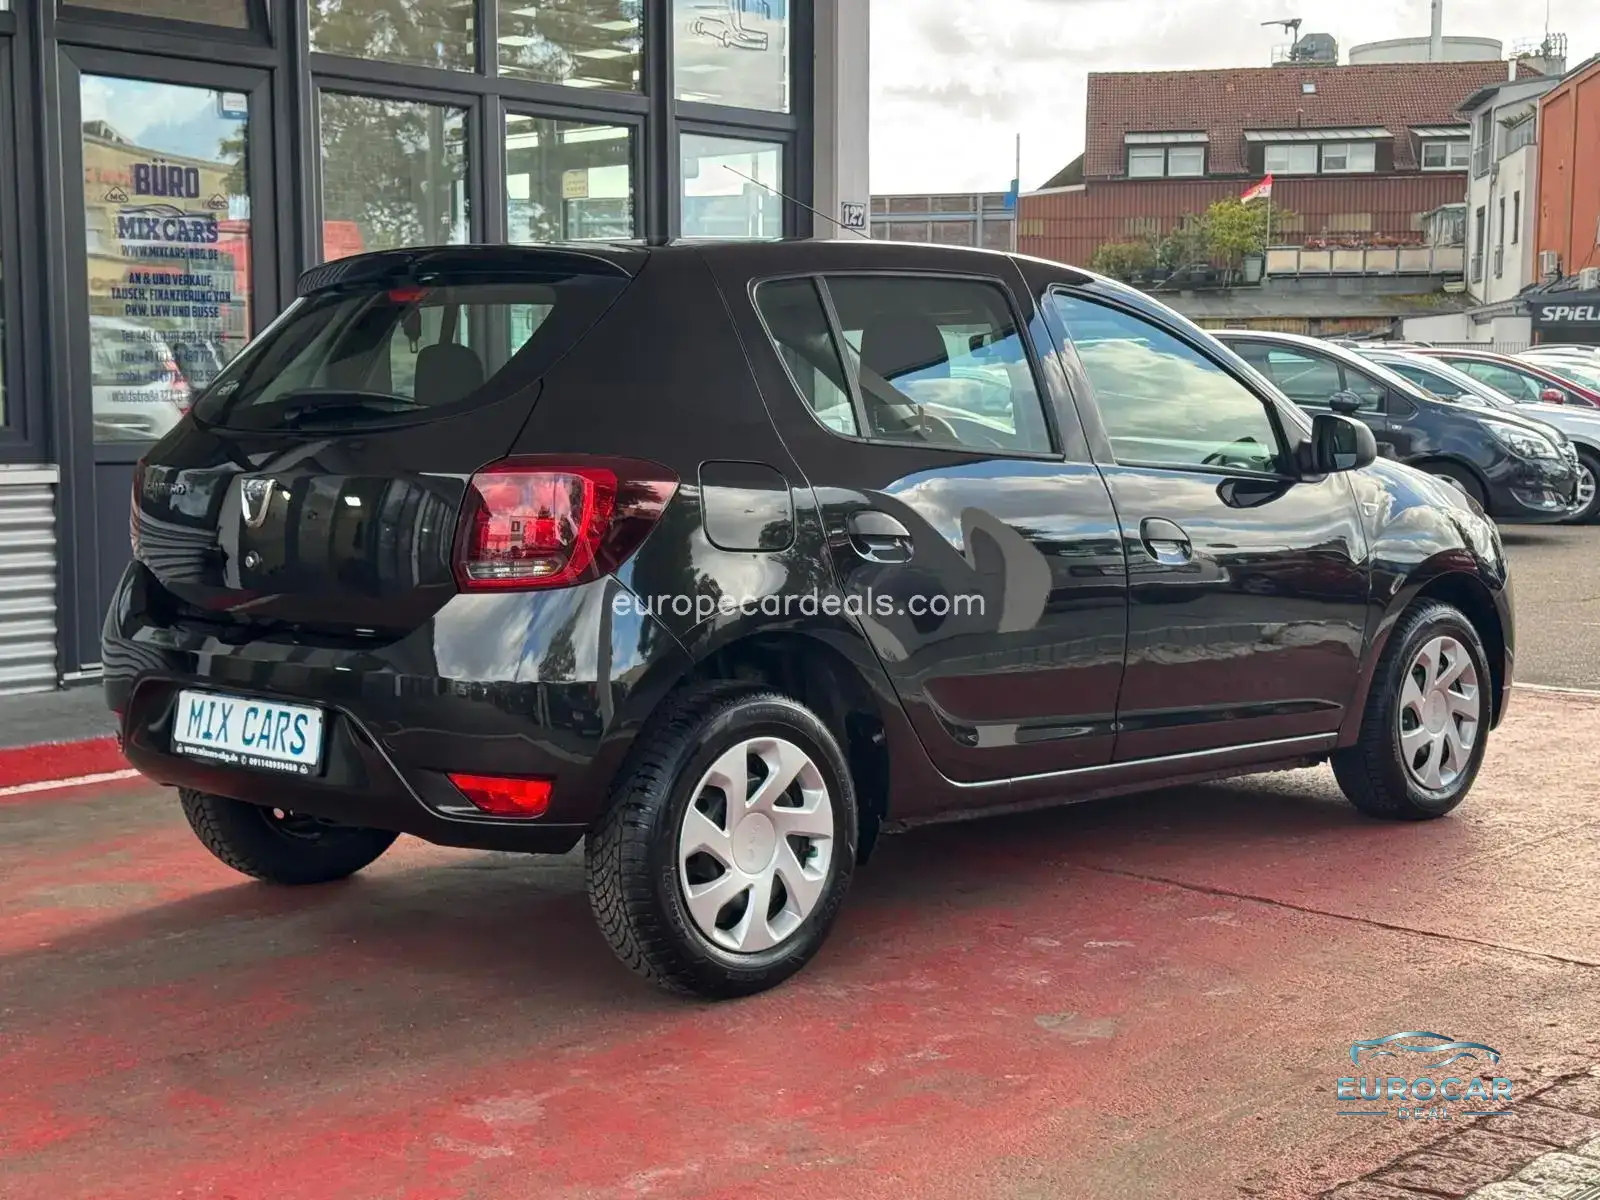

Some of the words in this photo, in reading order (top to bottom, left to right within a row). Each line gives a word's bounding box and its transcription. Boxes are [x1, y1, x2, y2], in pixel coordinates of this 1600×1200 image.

[134, 158, 199, 198] BÜRO
[845, 205, 864, 226] 127
[118, 216, 160, 240] MIX
[162, 219, 218, 243] CARS
[129, 272, 141, 285] AN
[153, 273, 171, 286] UND
[150, 289, 213, 303] FINANZIERUNG
[213, 290, 231, 304] VON
[151, 305, 170, 318] LKW
[172, 305, 190, 318] UND
[192, 306, 219, 319] BUSSE
[1540, 306, 1600, 321] SPiEL
[187, 698, 233, 743] MIX
[242, 706, 308, 755] CARS
